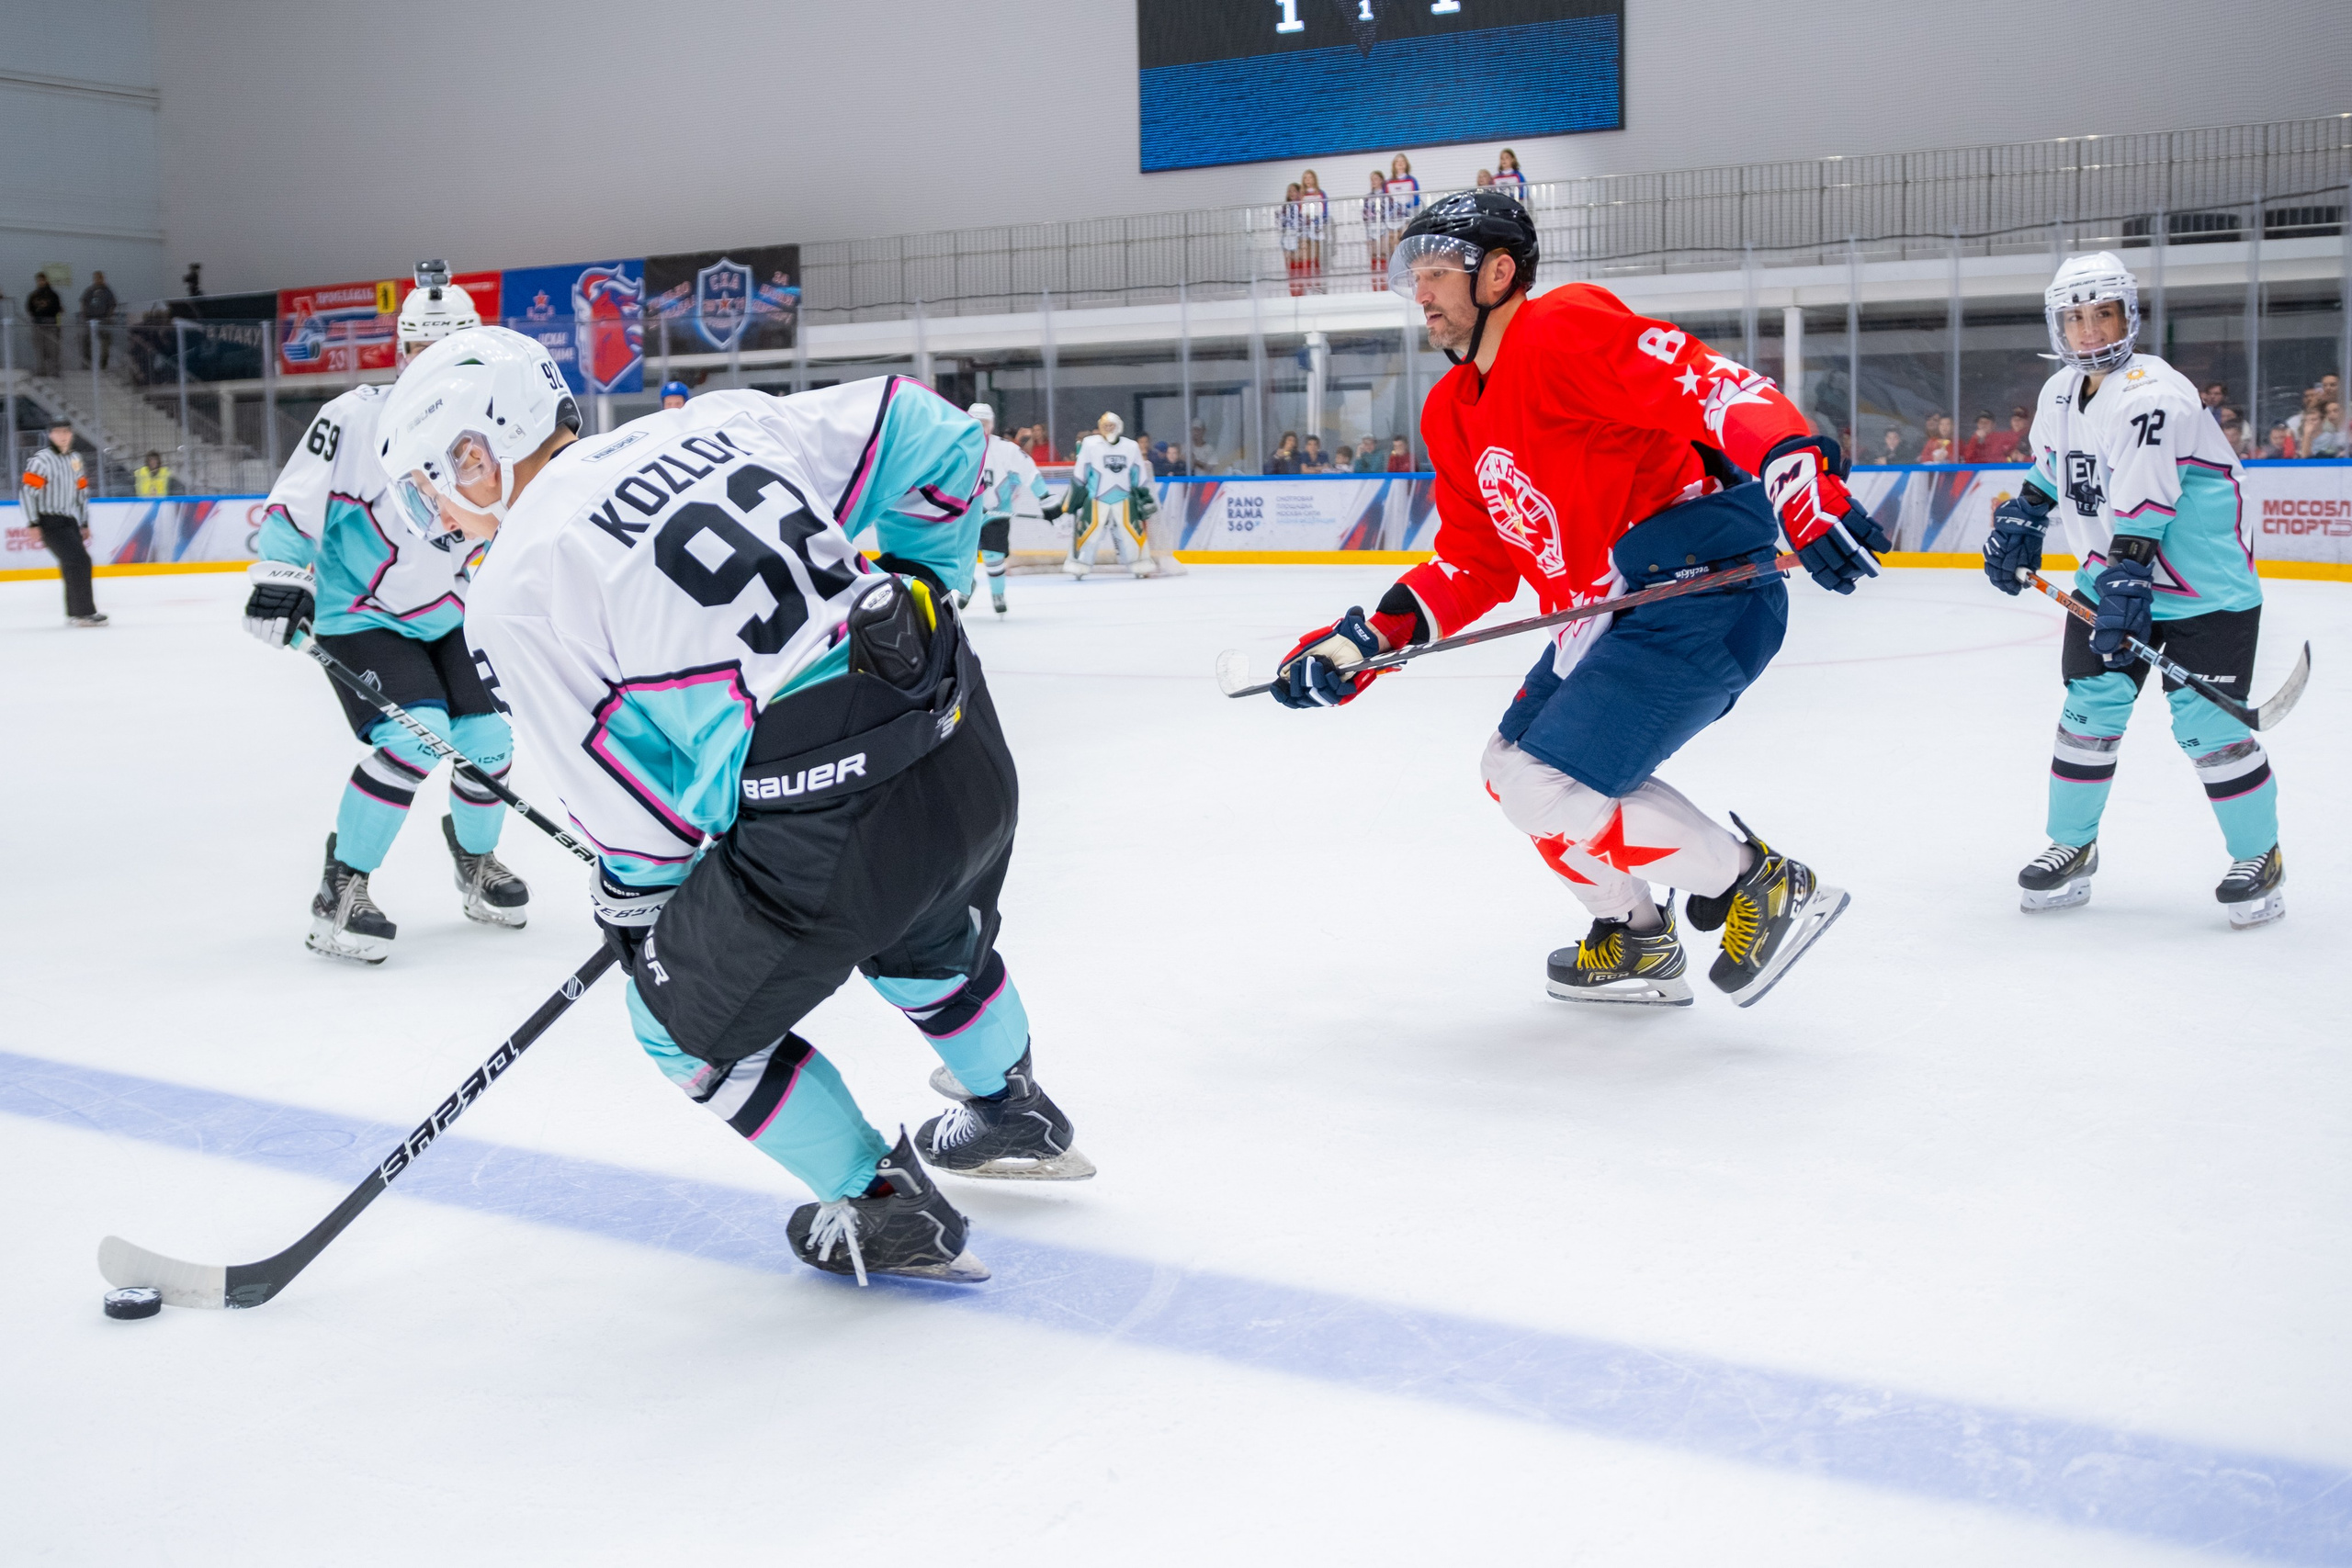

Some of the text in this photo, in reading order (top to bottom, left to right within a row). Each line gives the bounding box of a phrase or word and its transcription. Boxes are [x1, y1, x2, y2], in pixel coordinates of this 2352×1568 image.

[1638, 327, 1686, 365] 8
[540, 361, 564, 390] 92
[306, 417, 341, 461] 69
[2130, 408, 2166, 448] 72
[1227, 497, 1263, 507] PANO
[1227, 508, 1263, 519] RAMA
[2263, 519, 2333, 536] СПОРТ
[654, 463, 858, 655] 92
[2129, 640, 2190, 684] TRUE
